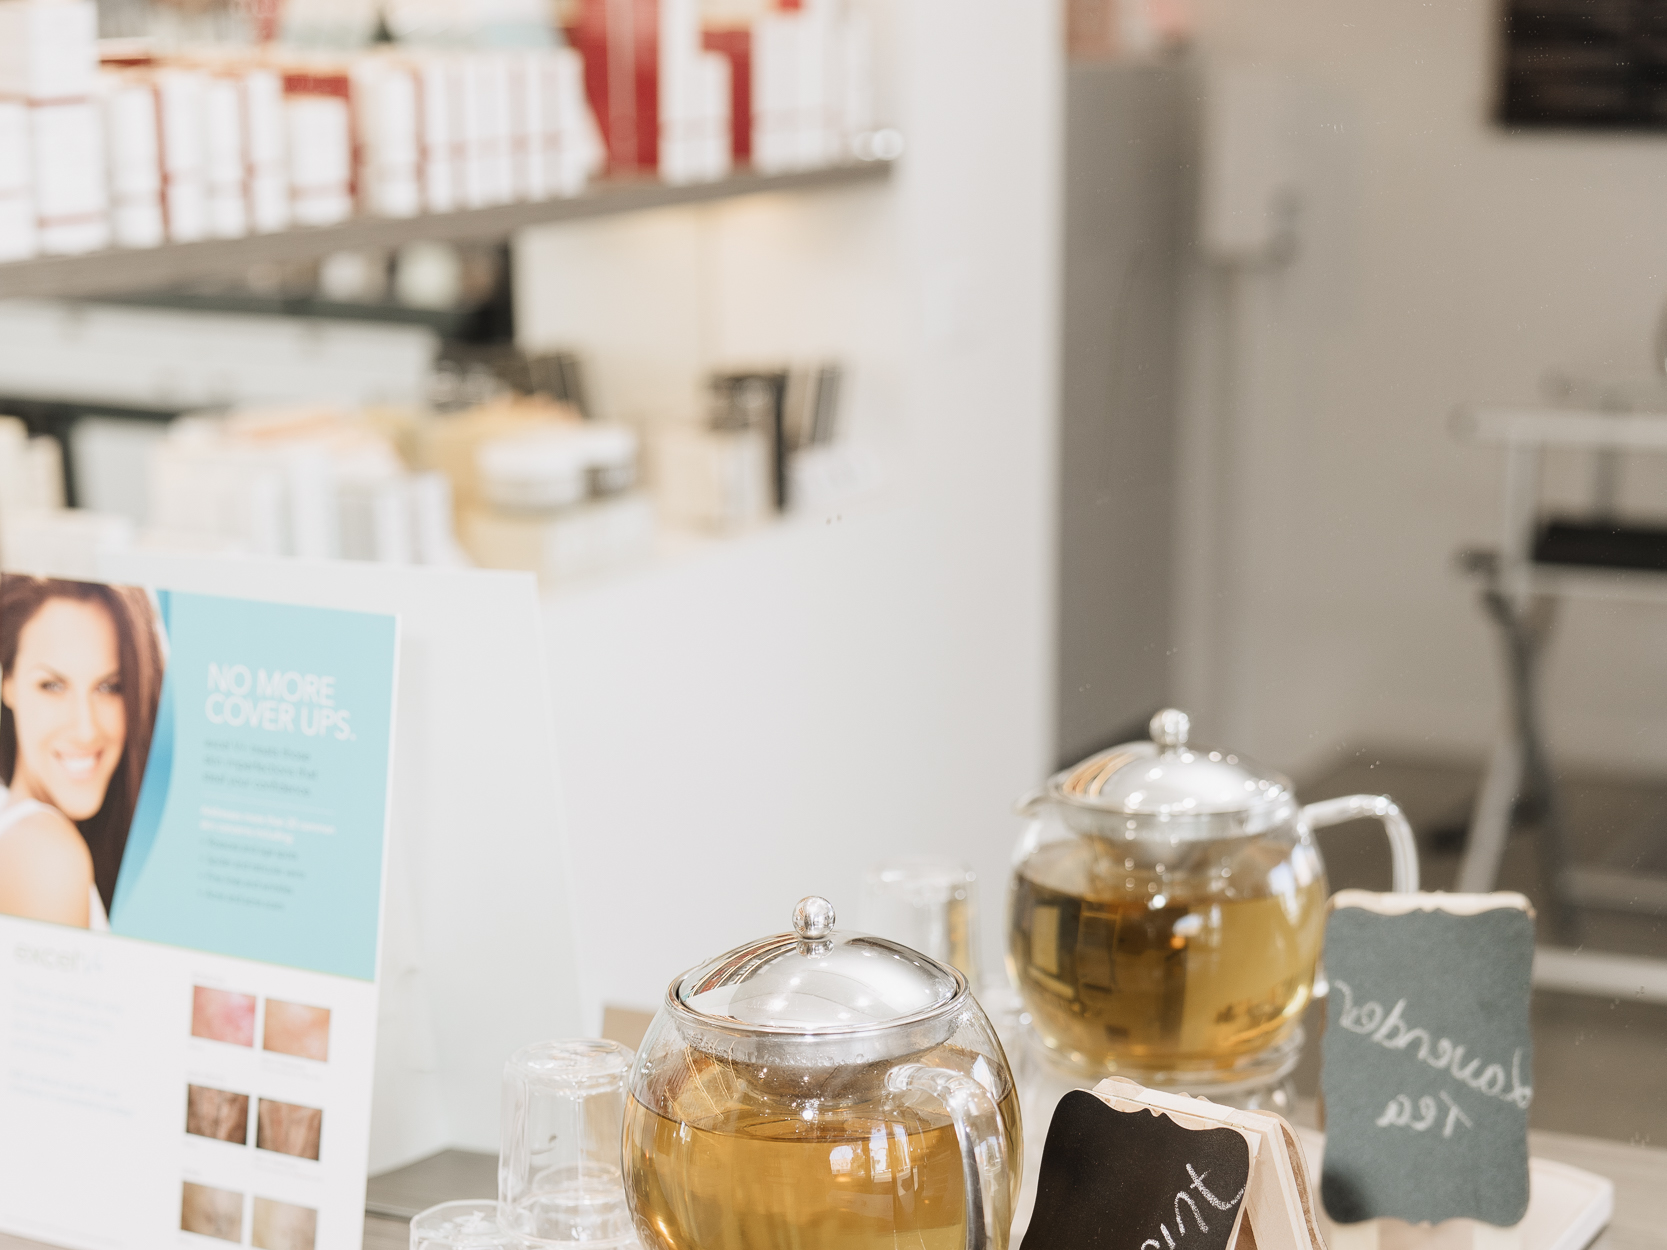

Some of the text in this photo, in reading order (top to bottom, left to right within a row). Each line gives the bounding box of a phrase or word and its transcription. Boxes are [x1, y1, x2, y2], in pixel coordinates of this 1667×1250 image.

[206, 661, 337, 707] NO MORE
[204, 692, 358, 742] COVER UPS.
